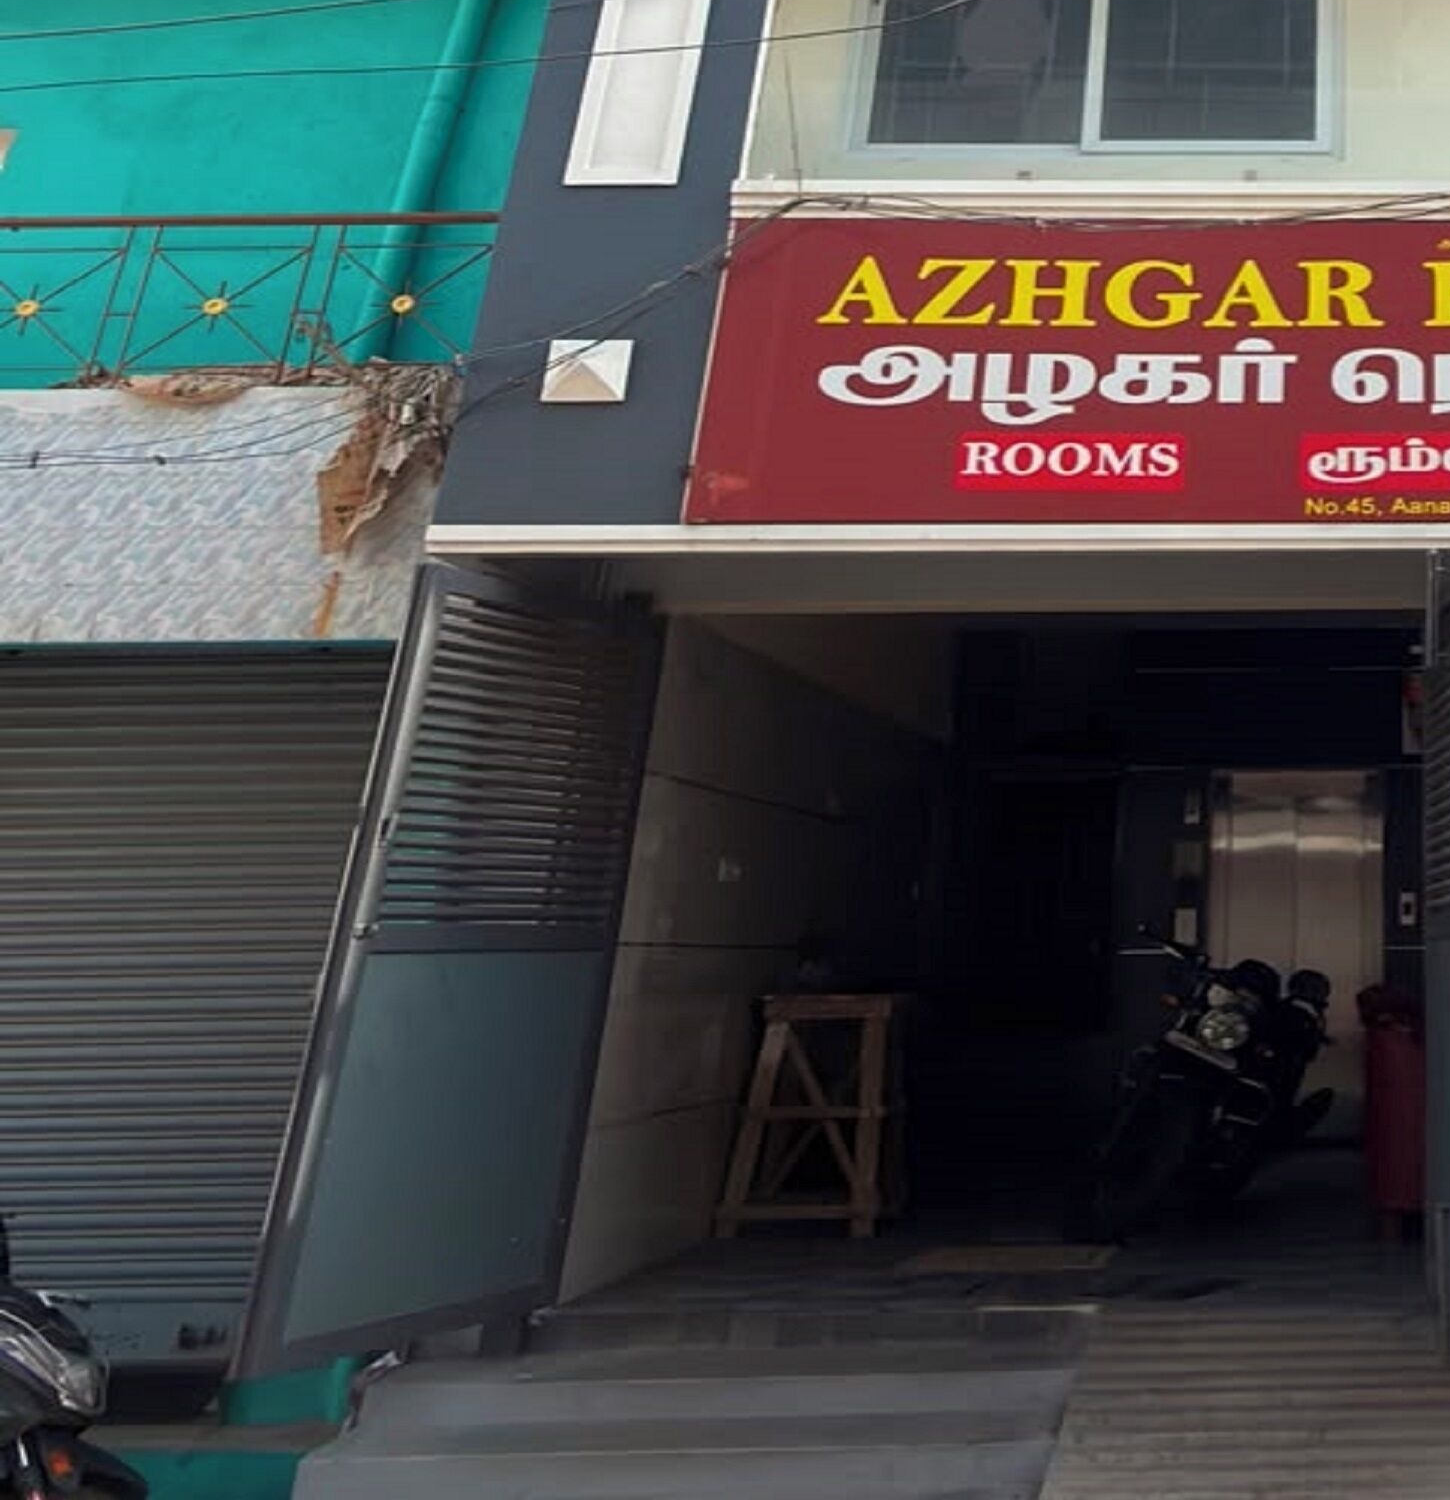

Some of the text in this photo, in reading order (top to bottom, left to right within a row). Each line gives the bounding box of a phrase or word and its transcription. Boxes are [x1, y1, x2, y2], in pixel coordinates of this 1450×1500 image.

[815, 255, 1386, 329] AZHGAR
[817, 336, 1299, 426] அழகர்
[960, 440, 1180, 478] ROOMS
[1304, 497, 1383, 517] No.45,
